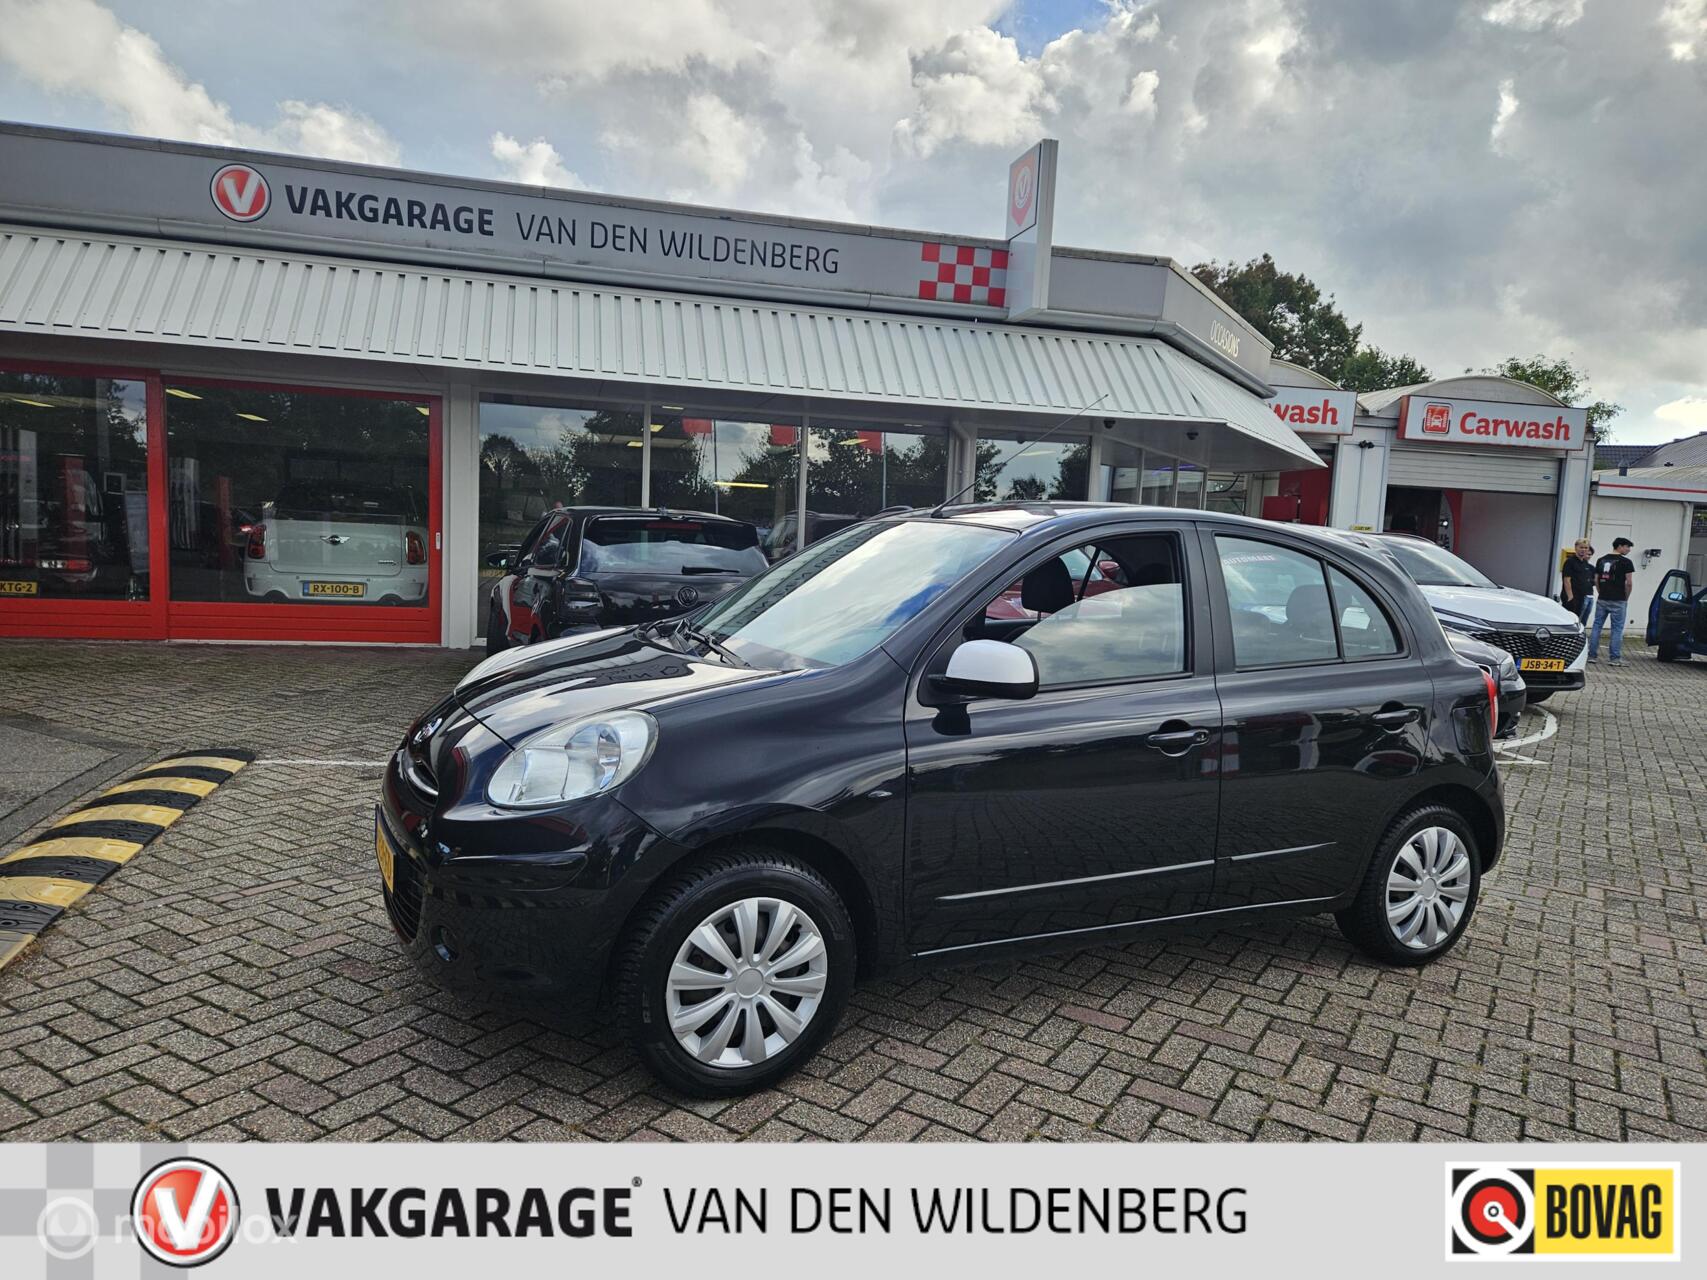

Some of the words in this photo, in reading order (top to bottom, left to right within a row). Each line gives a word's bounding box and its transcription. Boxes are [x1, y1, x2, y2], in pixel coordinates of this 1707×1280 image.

[285, 184, 494, 237] VAKGARAGE
[516, 212, 576, 246] VAN
[590, 221, 648, 254] DEN
[659, 229, 840, 274] WILDENBERG
[1460, 411, 1570, 441] Carwash
[313, 584, 360, 595] RX-100-B
[1525, 660, 1562, 670] JSB-34-T
